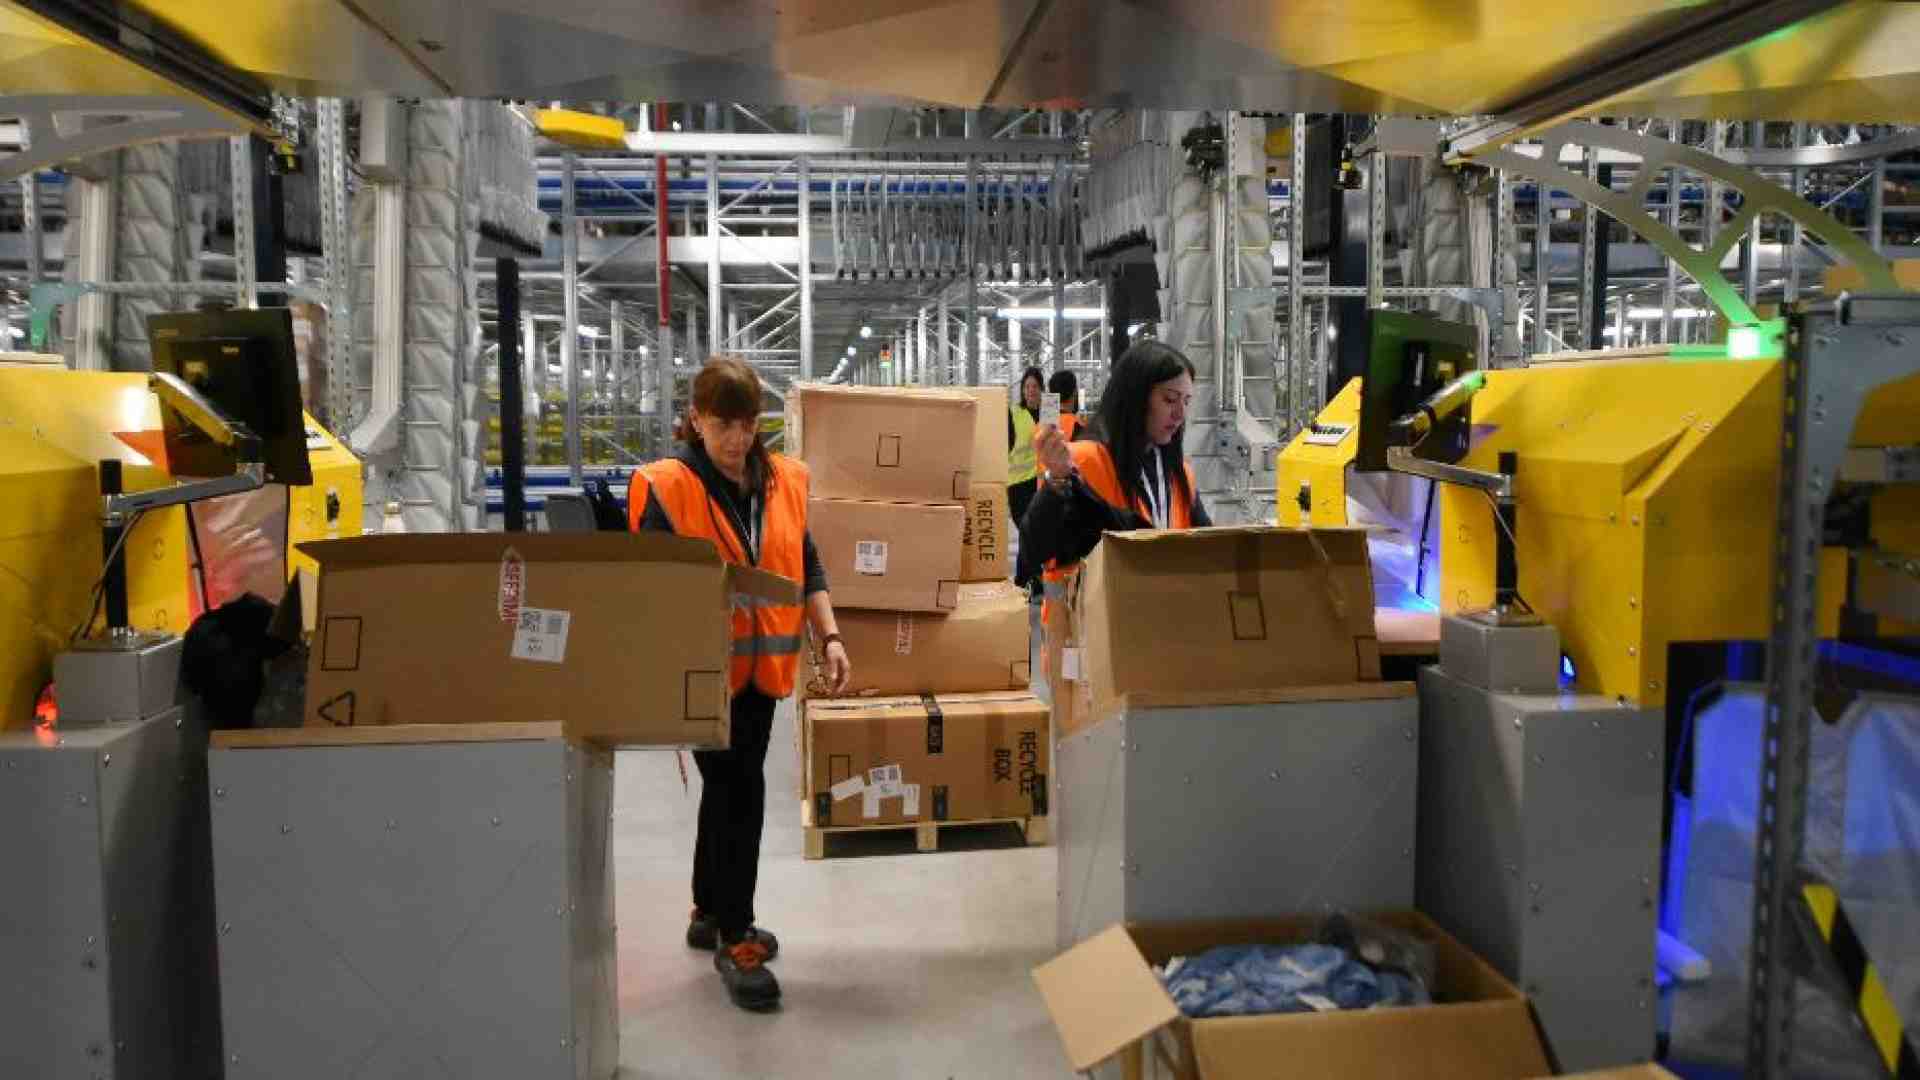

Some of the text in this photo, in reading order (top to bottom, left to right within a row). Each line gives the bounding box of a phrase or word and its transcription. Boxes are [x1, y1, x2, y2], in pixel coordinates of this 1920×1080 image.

[976, 499, 994, 561] RECYCLE
[993, 747, 1011, 782] BOX
[1018, 730, 1037, 796] RECYCLE
